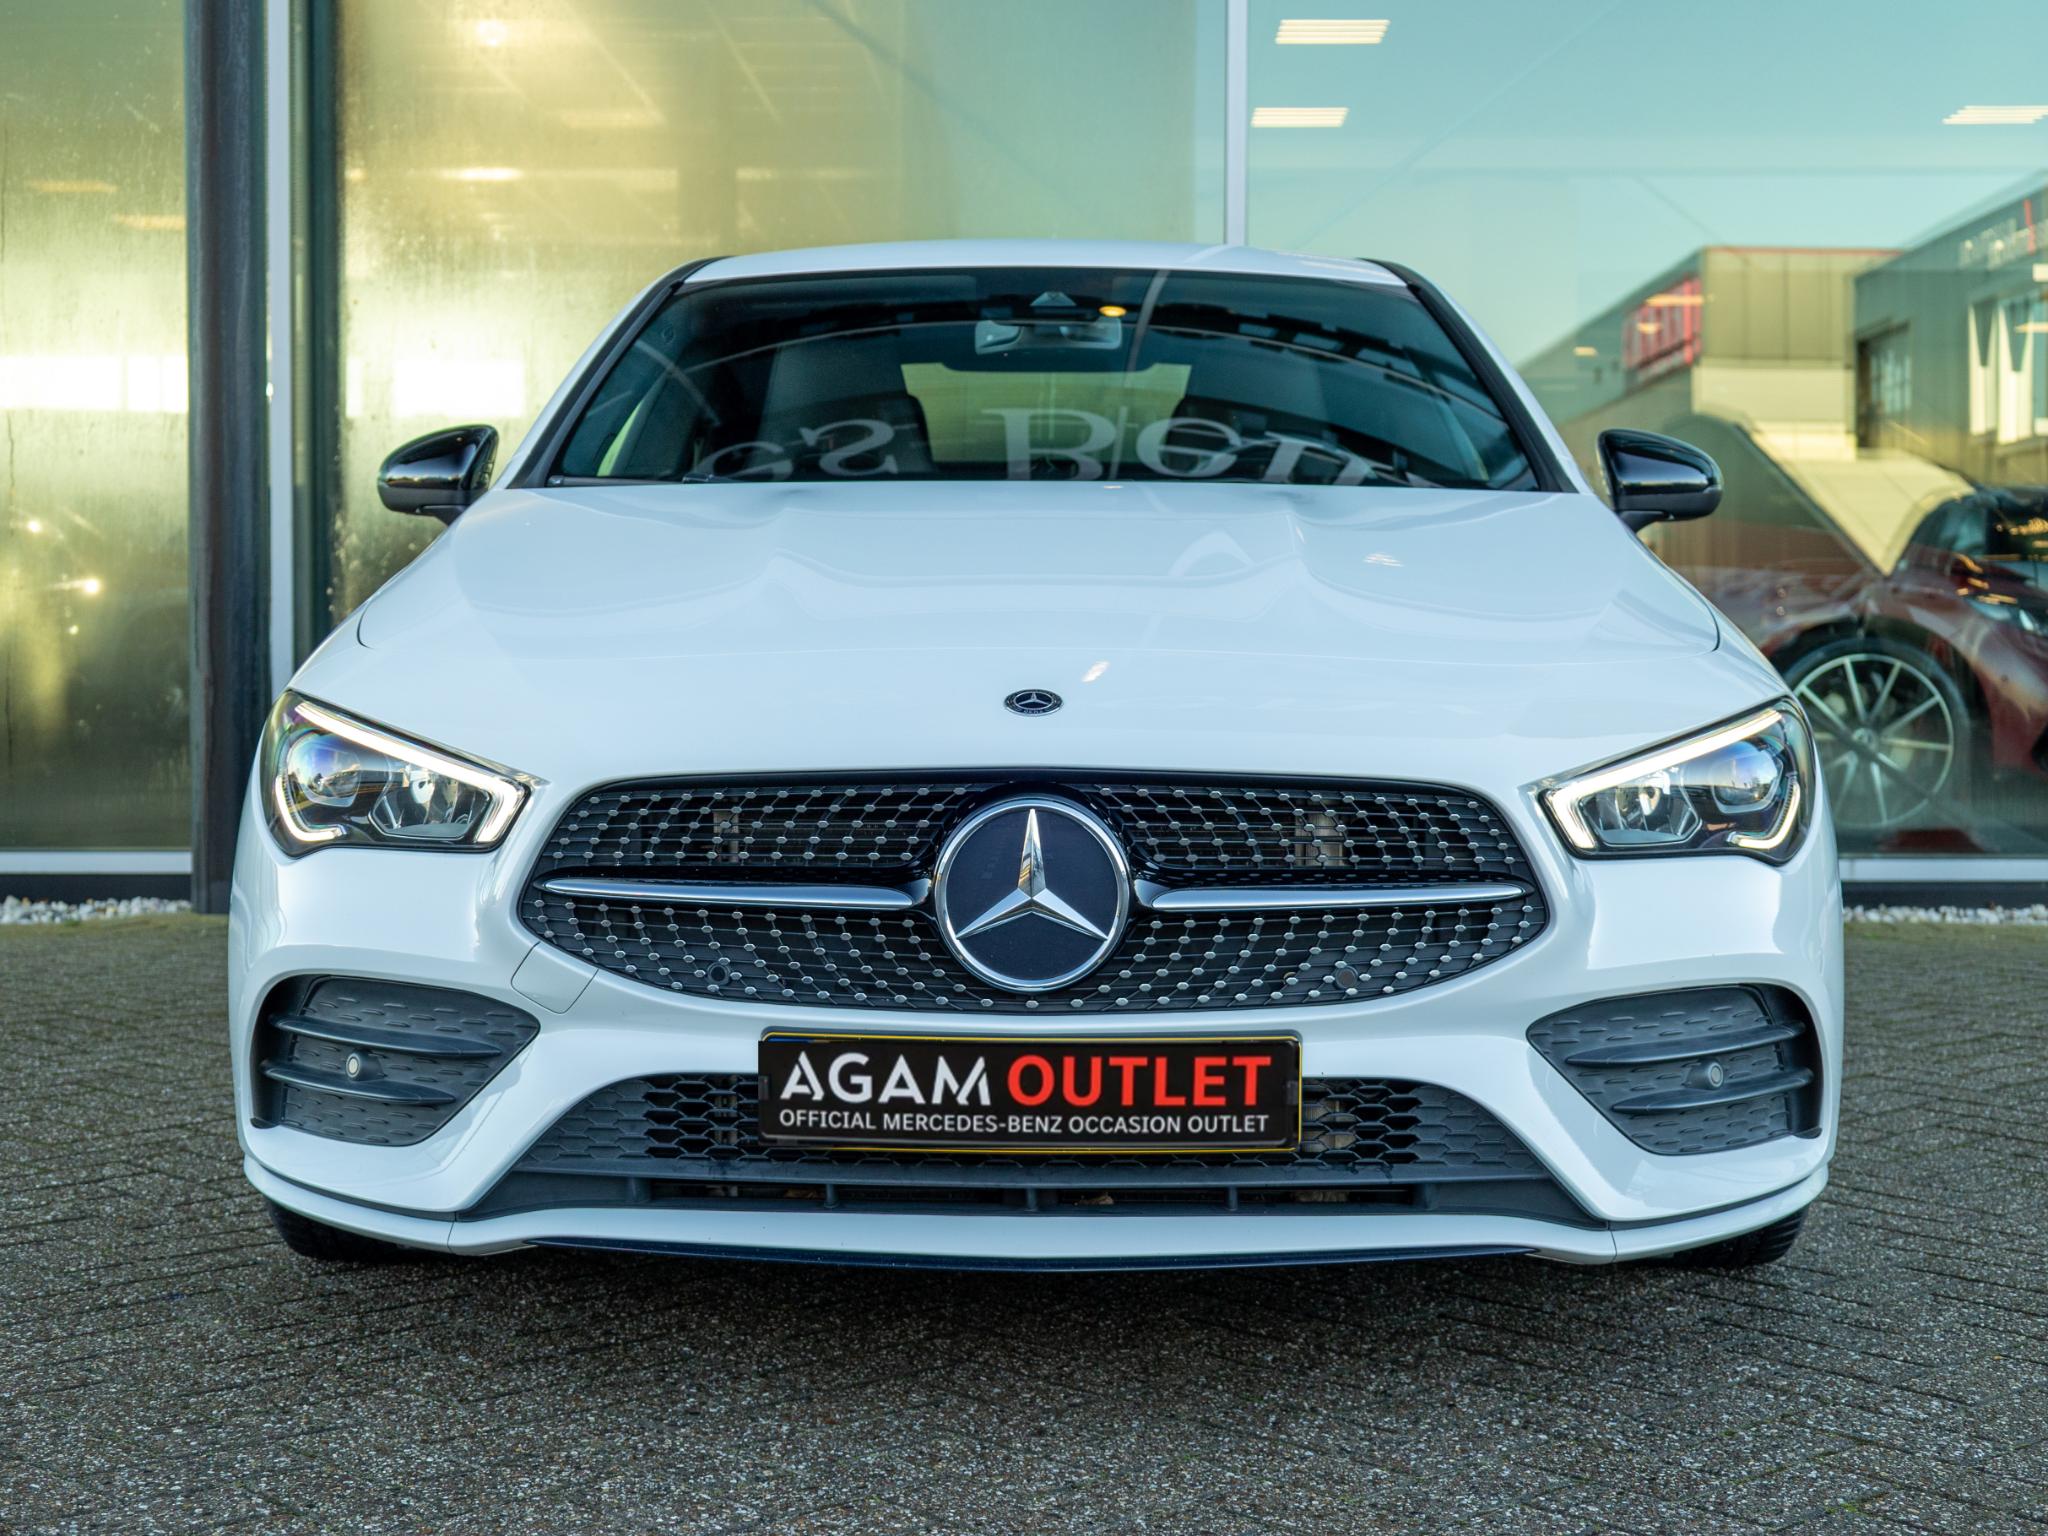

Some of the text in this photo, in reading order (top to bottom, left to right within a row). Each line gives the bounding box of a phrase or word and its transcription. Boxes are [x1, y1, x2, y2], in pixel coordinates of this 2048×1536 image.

[780, 1050, 1272, 1107] AGAM OUTLET
[779, 1108, 1270, 1134] OFFICIAL MERCEDES-BENZ OCCASION OUTLET
